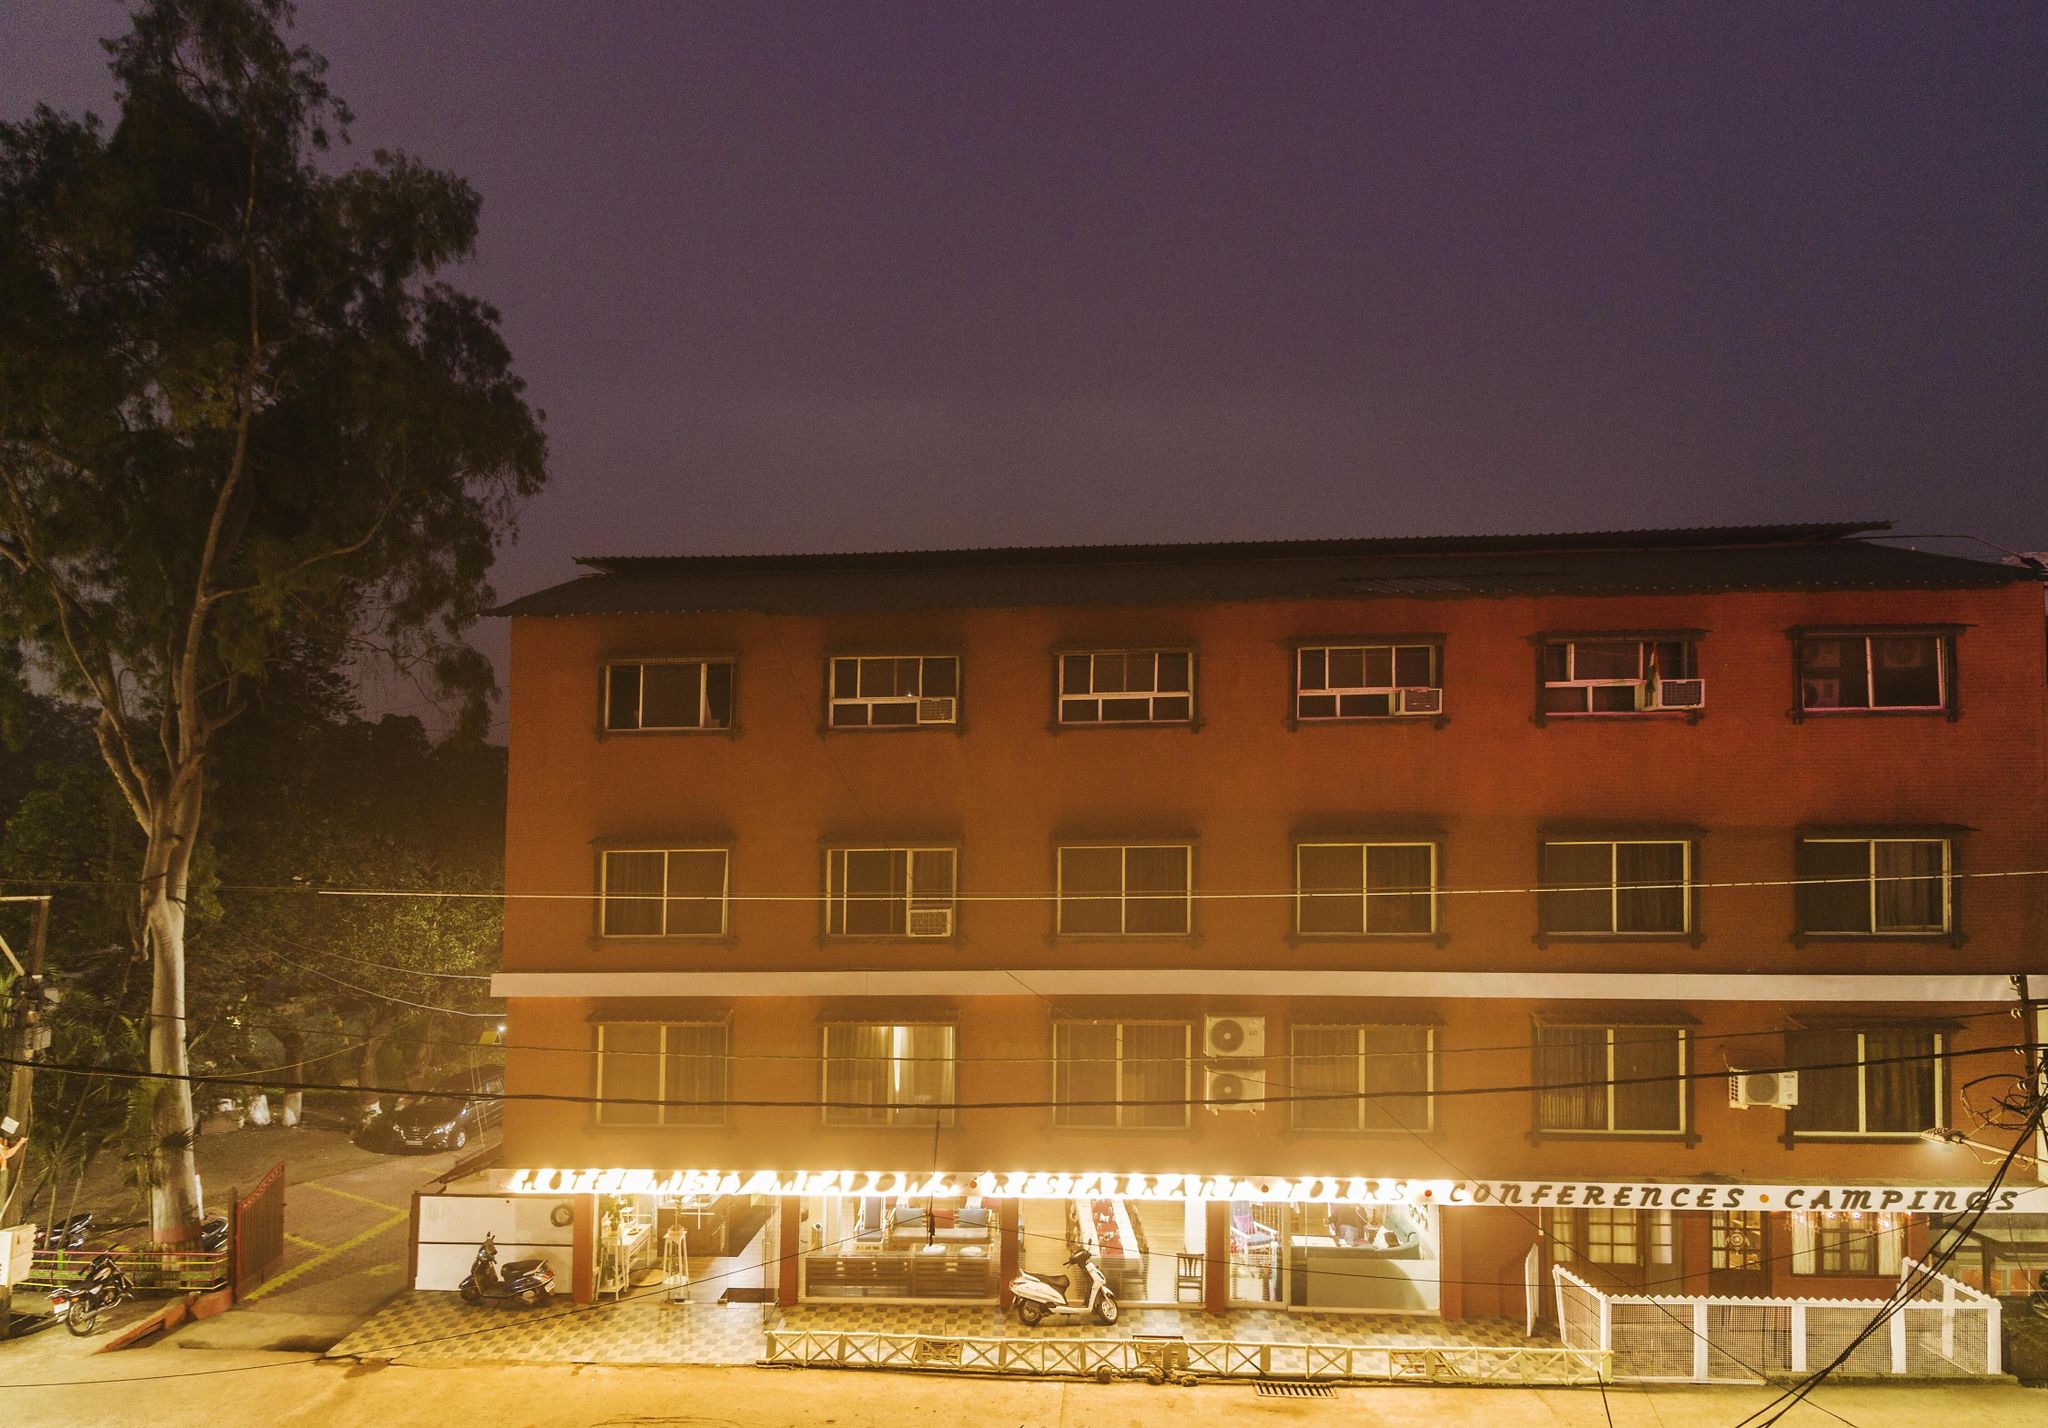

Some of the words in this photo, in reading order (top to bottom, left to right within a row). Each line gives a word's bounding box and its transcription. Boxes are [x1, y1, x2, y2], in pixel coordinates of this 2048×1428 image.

[769, 1172, 957, 1193] MEADOWS
[991, 1173, 1246, 1198] RESTAURANT
[1283, 1178, 1408, 1201] TOURS
[1449, 1182, 1745, 1209] CONFERENCES
[1783, 1189, 2019, 1212] CAMPINGS
